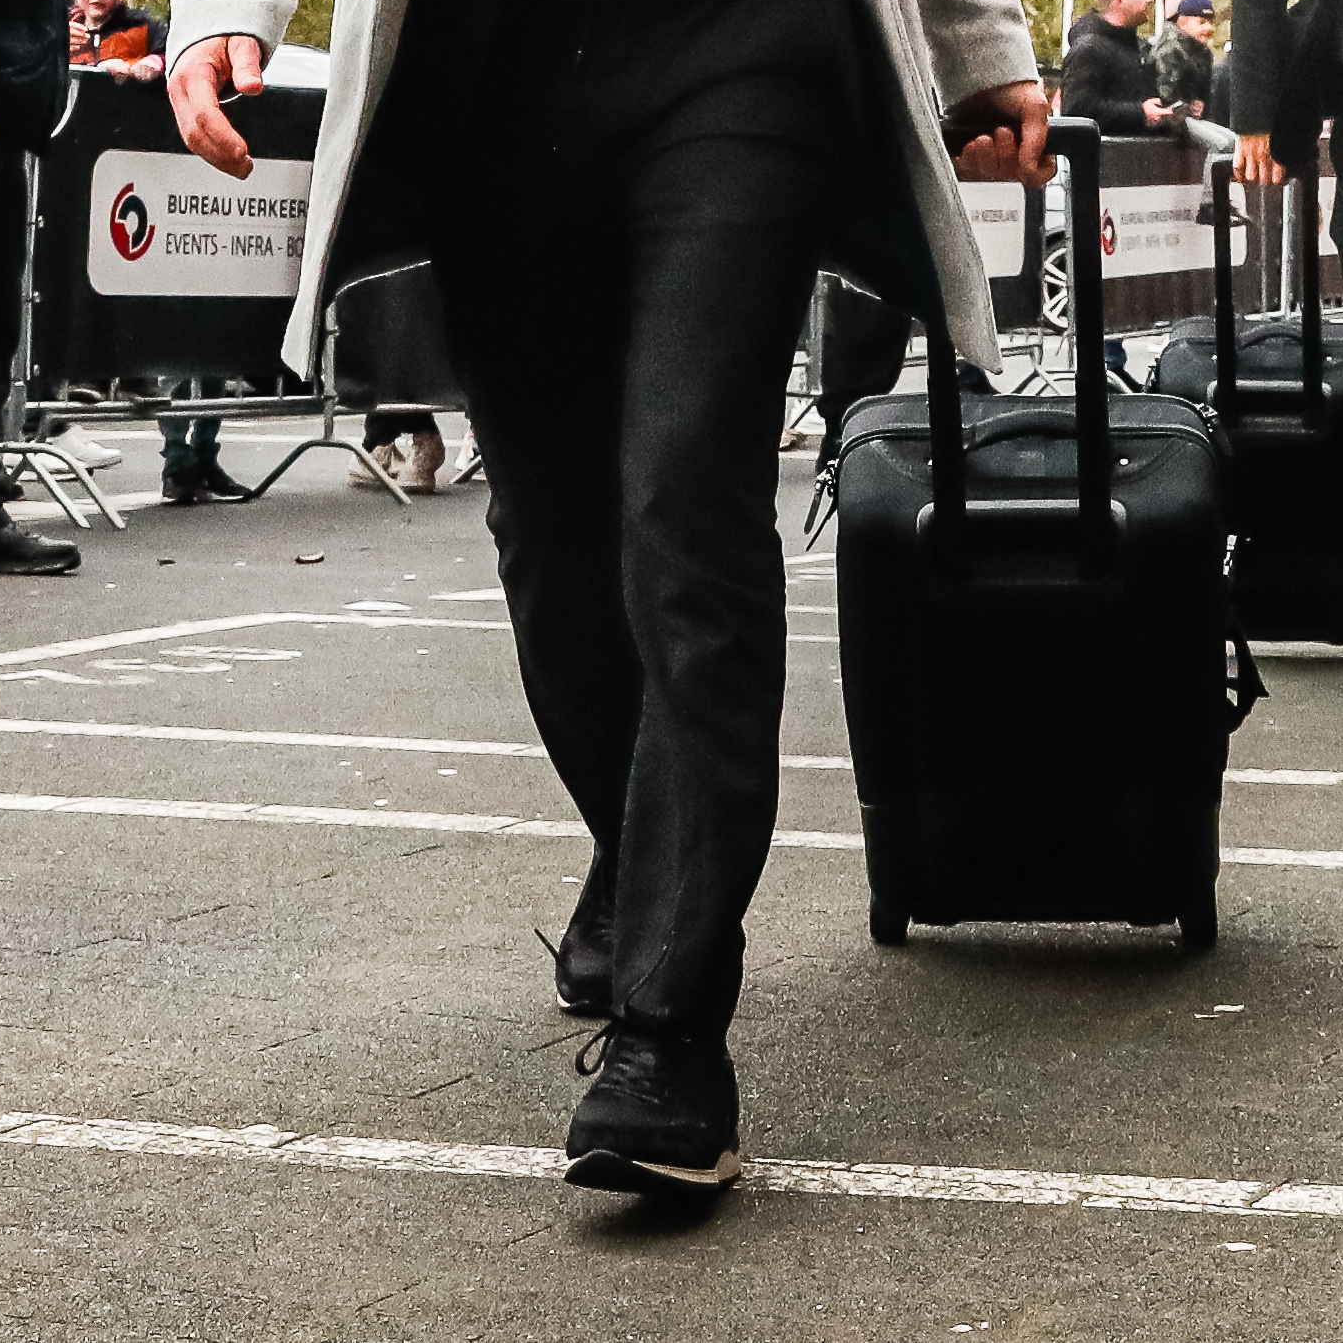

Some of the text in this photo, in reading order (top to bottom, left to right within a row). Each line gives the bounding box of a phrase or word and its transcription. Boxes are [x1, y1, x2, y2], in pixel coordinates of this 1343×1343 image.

[168, 194, 232, 216] BUREAU
[165, 232, 218, 256] EVENTS
[231, 234, 273, 257] INFRA
